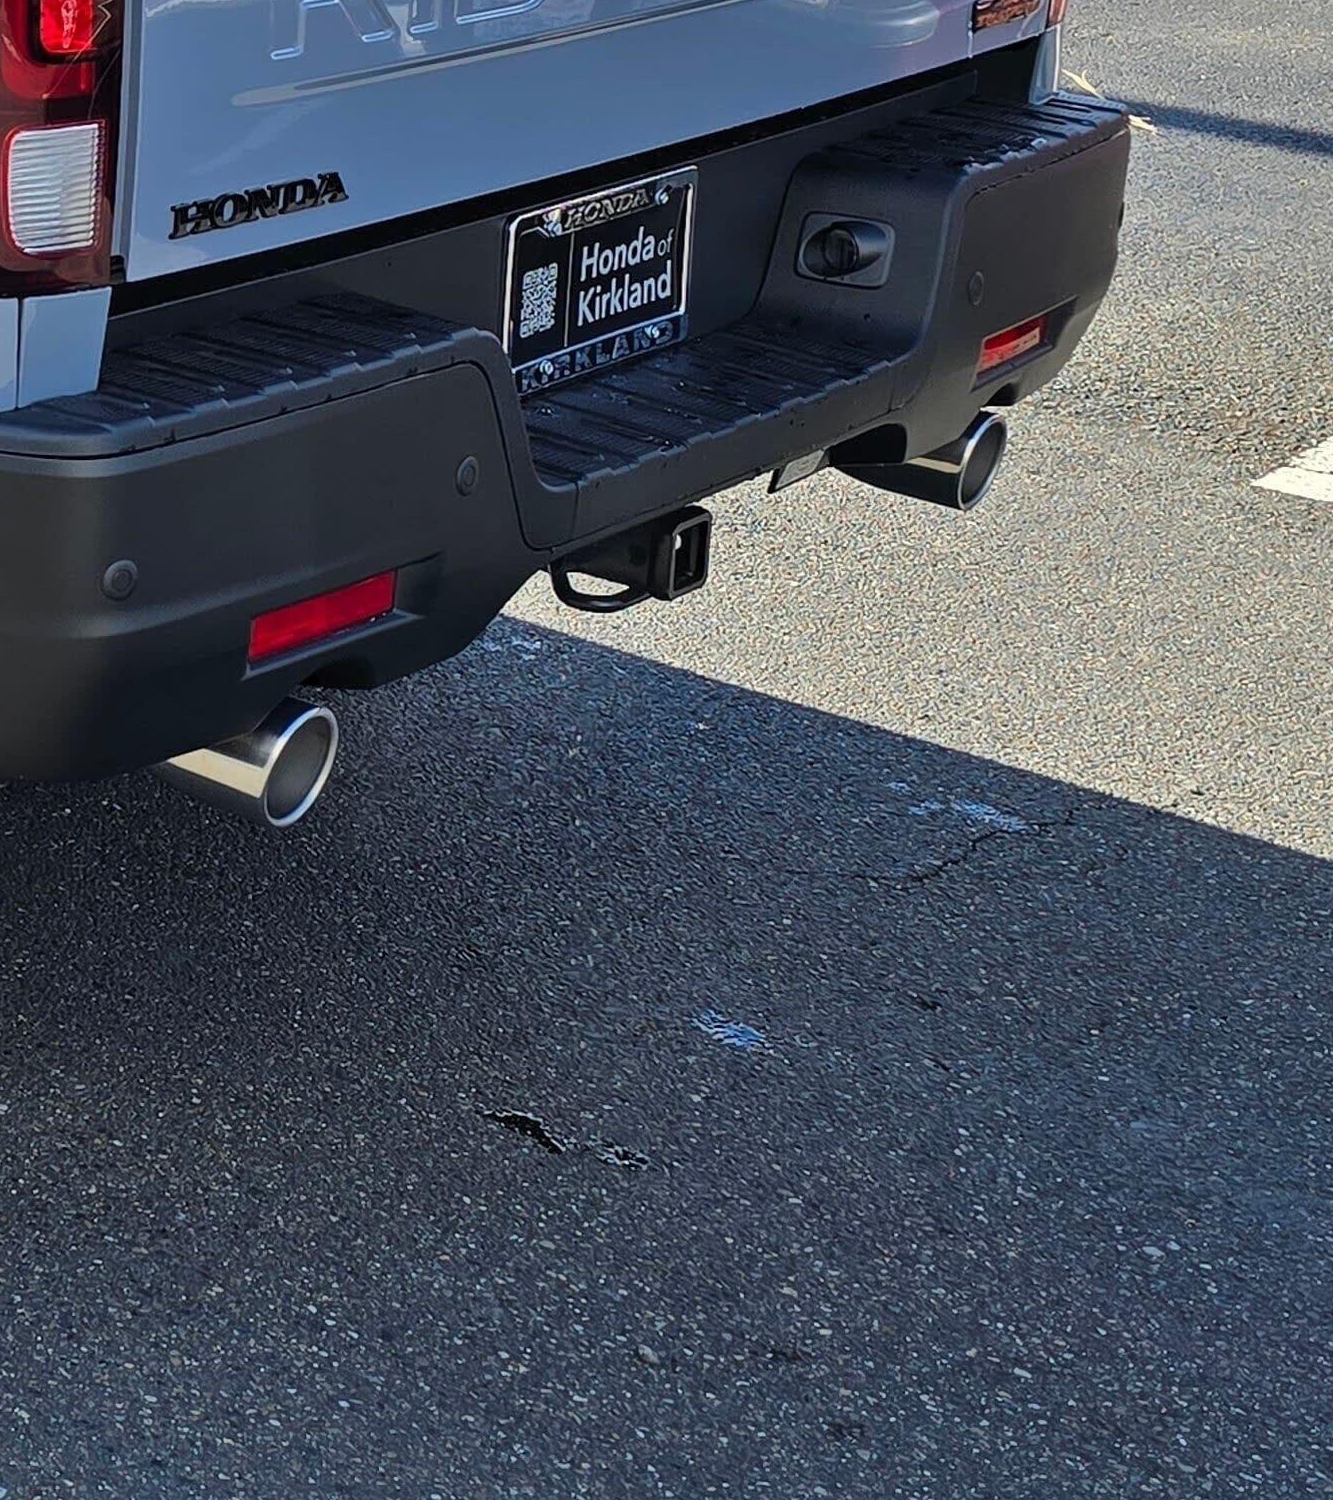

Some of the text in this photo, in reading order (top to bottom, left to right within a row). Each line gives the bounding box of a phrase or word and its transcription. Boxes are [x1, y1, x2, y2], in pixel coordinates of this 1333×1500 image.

[168, 171, 350, 240] HONDA
[563, 188, 650, 229] HONDA
[580, 226, 676, 282] Honda of
[577, 259, 673, 327] Kirkland
